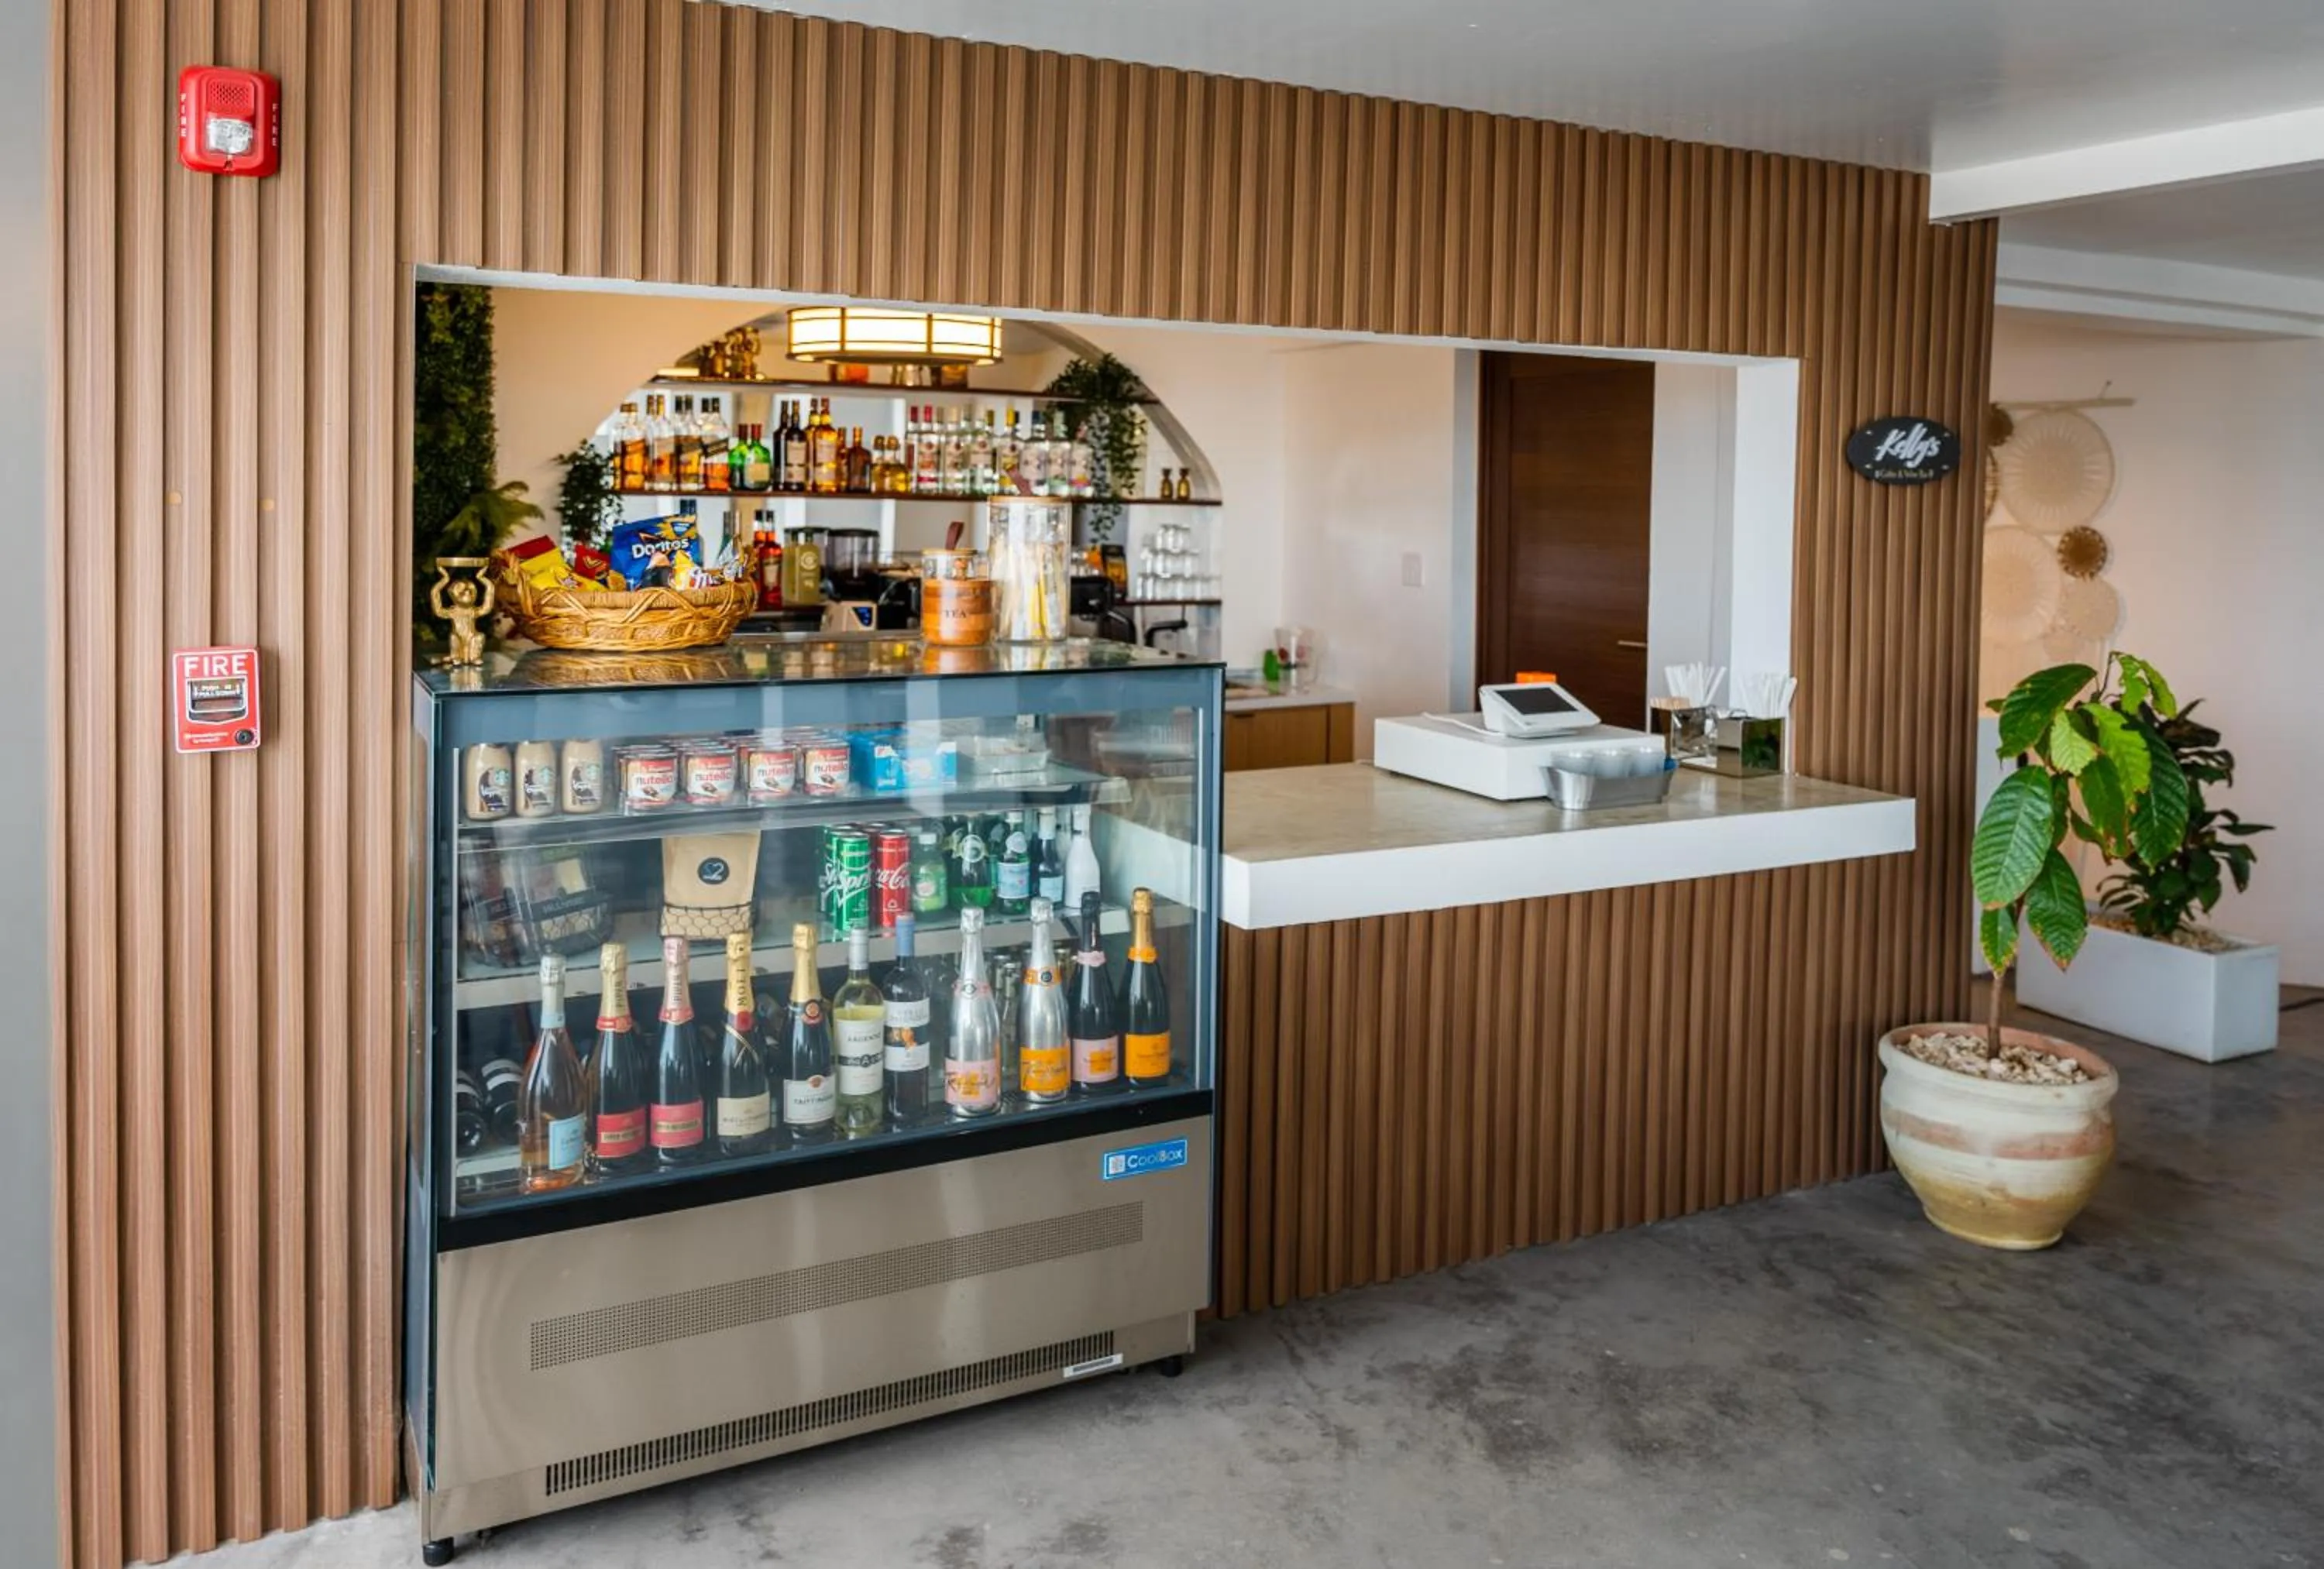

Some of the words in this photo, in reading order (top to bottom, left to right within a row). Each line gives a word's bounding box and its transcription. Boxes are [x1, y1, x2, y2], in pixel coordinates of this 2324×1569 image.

[631, 537, 689, 558] Doritos
[944, 609, 967, 619] TEA
[184, 654, 248, 677] FIRE
